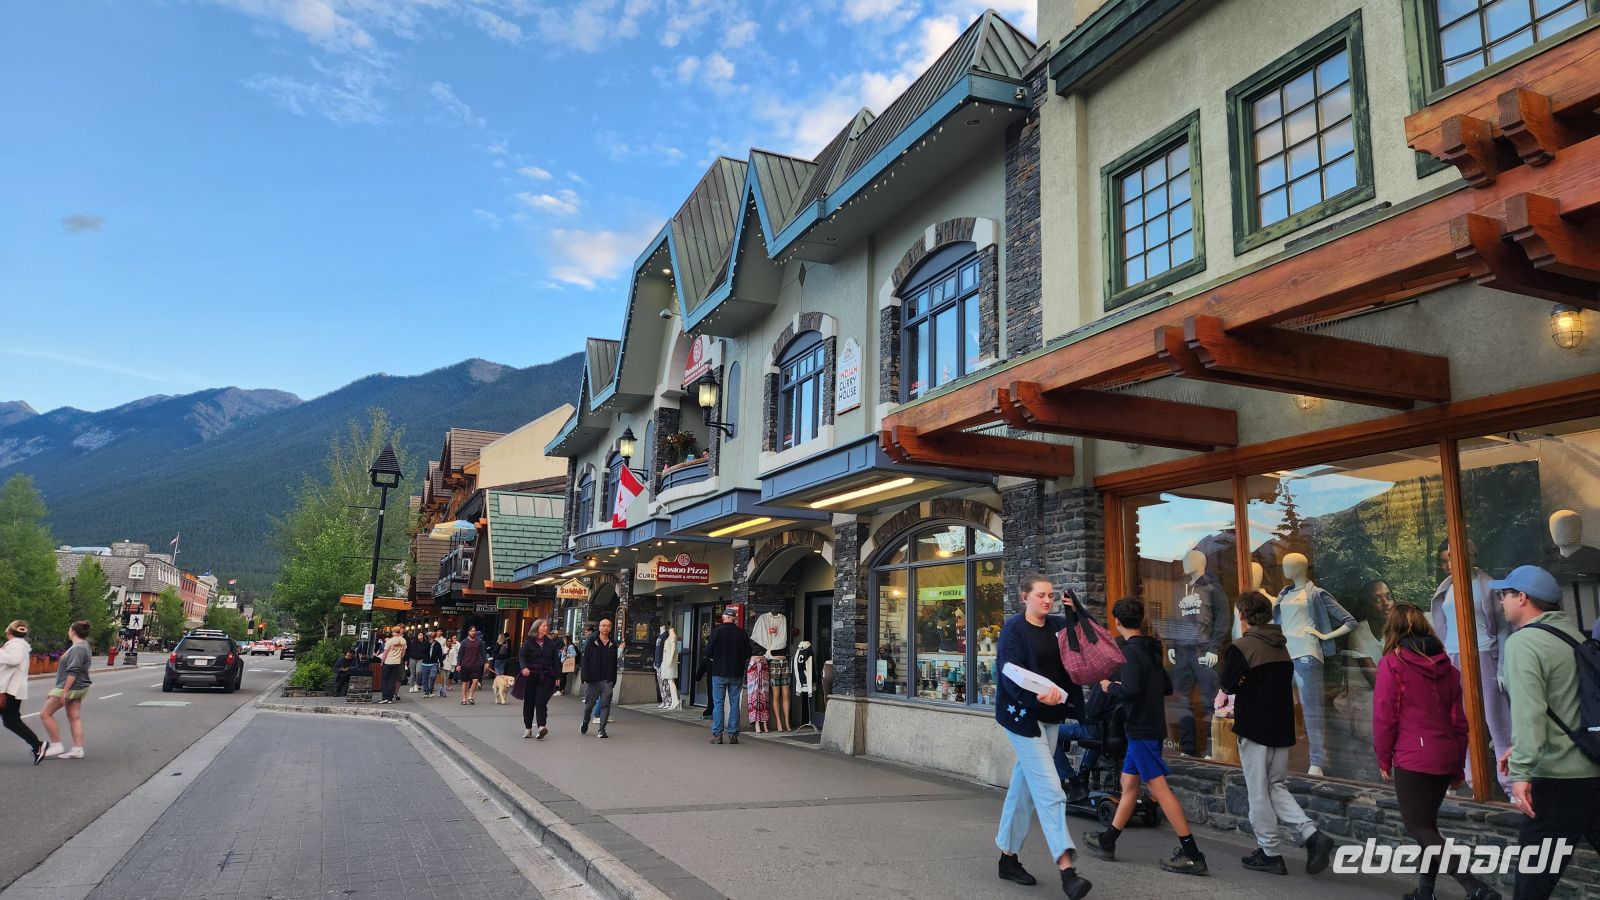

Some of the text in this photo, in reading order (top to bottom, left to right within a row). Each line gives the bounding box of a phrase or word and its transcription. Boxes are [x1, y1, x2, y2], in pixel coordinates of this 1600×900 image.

[838, 365, 858, 381] INDIAN
[839, 375, 857, 391] CURRY
[838, 386, 857, 402] HOUSE
[658, 565, 686, 573] Boston
[798, 654, 804, 664] C
